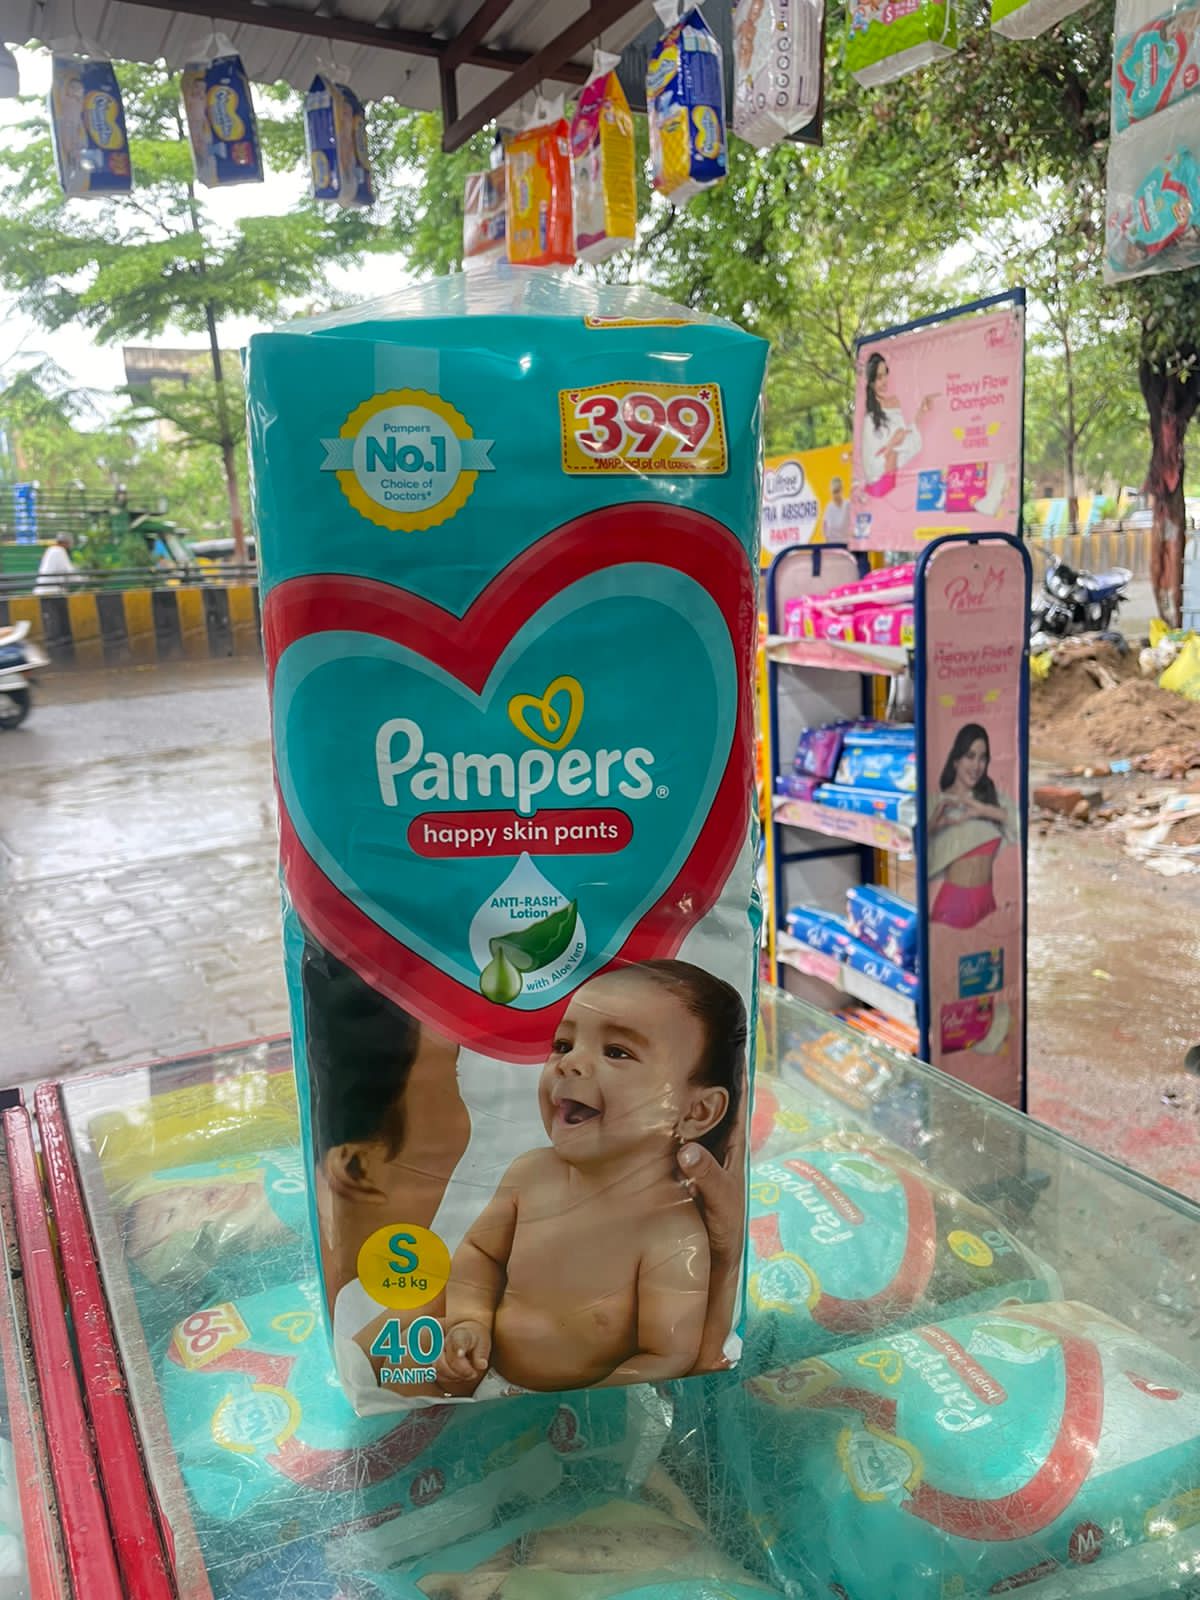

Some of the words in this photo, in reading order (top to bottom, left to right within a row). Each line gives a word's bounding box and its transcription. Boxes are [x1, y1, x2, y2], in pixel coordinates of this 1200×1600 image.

[946, 379, 980, 397] Heavy
[950, 393, 1005, 411] Champion
[383, 423, 431, 435] Pampers
[366, 435, 446, 472] No.1
[380, 478, 420, 489] Choice
[422, 478, 433, 489] of
[782, 500, 818, 520] ABSORB
[937, 663, 1009, 681] Champion
[376, 718, 655, 813] Pampers
[424, 824, 496, 848] happy
[503, 821, 548, 841] skin
[555, 822, 618, 845] pants
[510, 907, 548, 919] Lotion
[526, 978, 550, 991] with
[551, 963, 572, 982] Aloe
[388, 1232, 419, 1274] S
[382, 1277, 407, 1289] 4-8
[410, 1276, 428, 1290] kg
[370, 1316, 444, 1365] 40
[380, 1368, 437, 1384] PANTS
[965, 1366, 1000, 1400] happy
[419, 1473, 438, 1497] M
[1077, 1528, 1096, 1554] M
